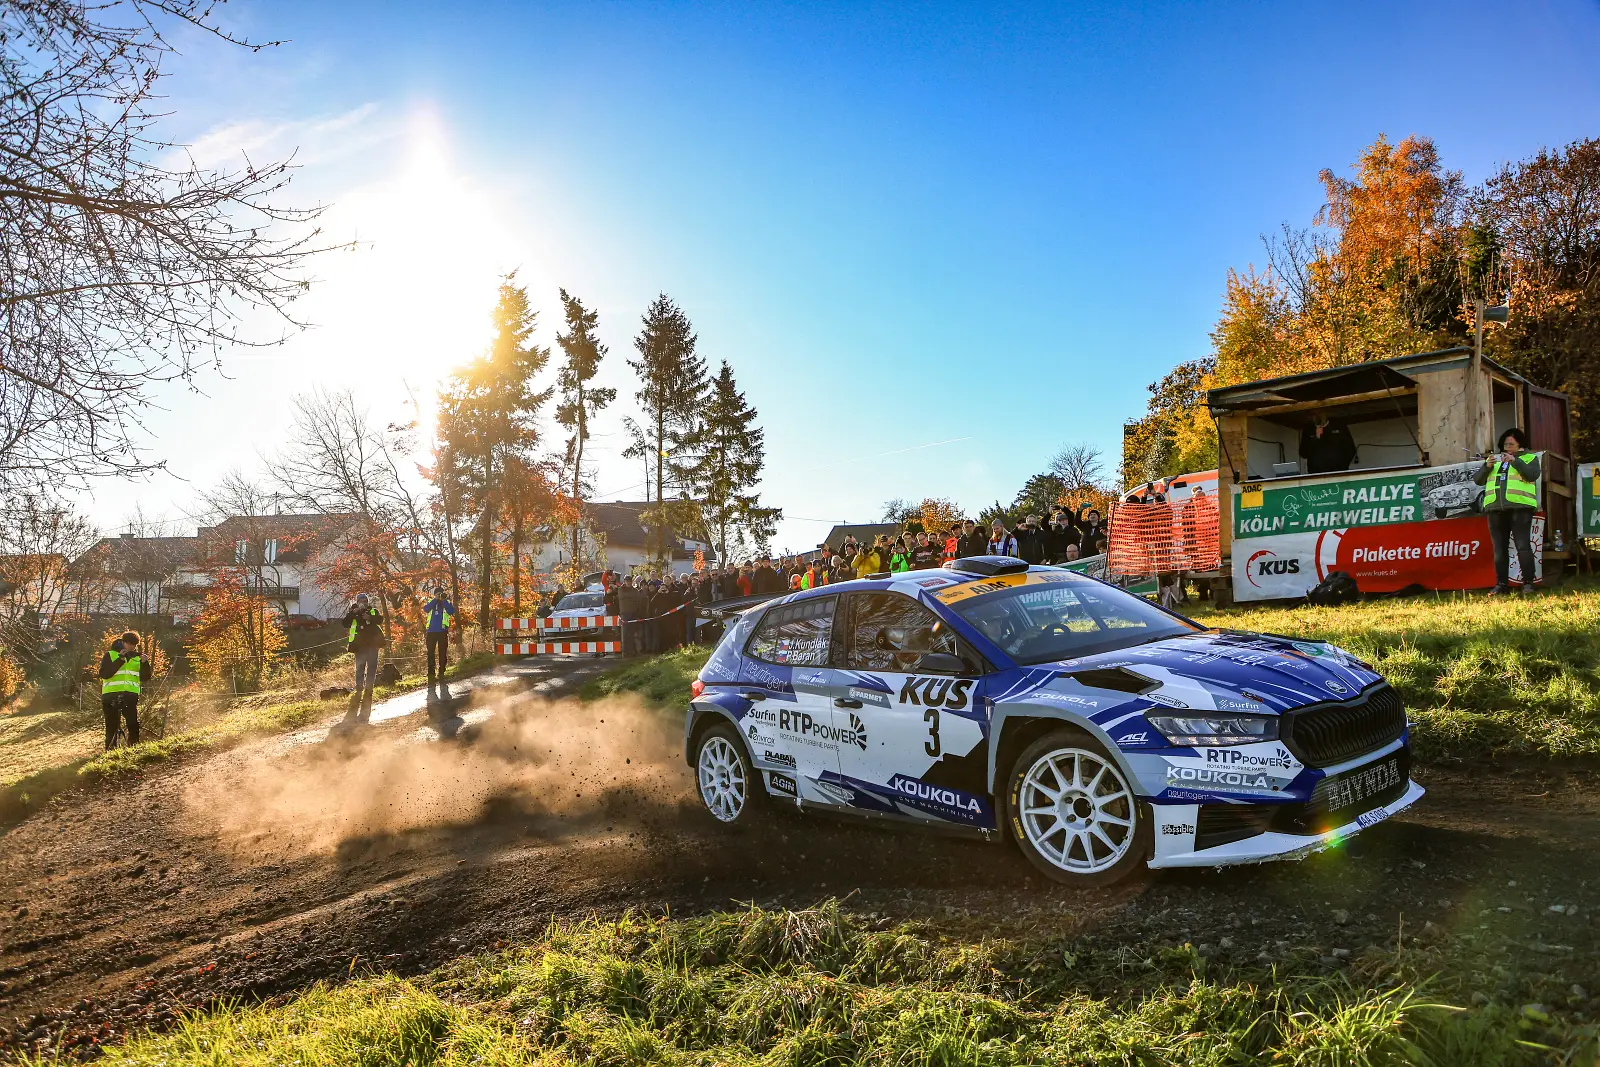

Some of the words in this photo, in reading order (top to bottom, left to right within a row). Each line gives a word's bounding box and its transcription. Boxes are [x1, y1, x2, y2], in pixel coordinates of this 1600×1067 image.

[1242, 484, 1262, 493] ADAC
[1343, 483, 1416, 504] RALLYE
[1240, 515, 1286, 533] KÖLN
[1304, 505, 1416, 528] AHRWEILER
[1353, 546, 1421, 563] Plakette
[1425, 540, 1480, 560] fällig?
[1259, 558, 1300, 576] KÜS
[1356, 569, 1398, 577] www.kues.de
[969, 581, 1013, 595] ADAC
[856, 691, 883, 702] FARMET
[899, 676, 974, 709] KÜS
[1031, 693, 1098, 708] KOUKOLA
[1229, 700, 1260, 709] Surfin
[748, 708, 776, 721] Surfin
[923, 709, 941, 757] 3
[1167, 766, 1268, 788] KOUKOLA
[894, 777, 982, 813] KOUKOLA
[920, 801, 975, 820] MACHINING
